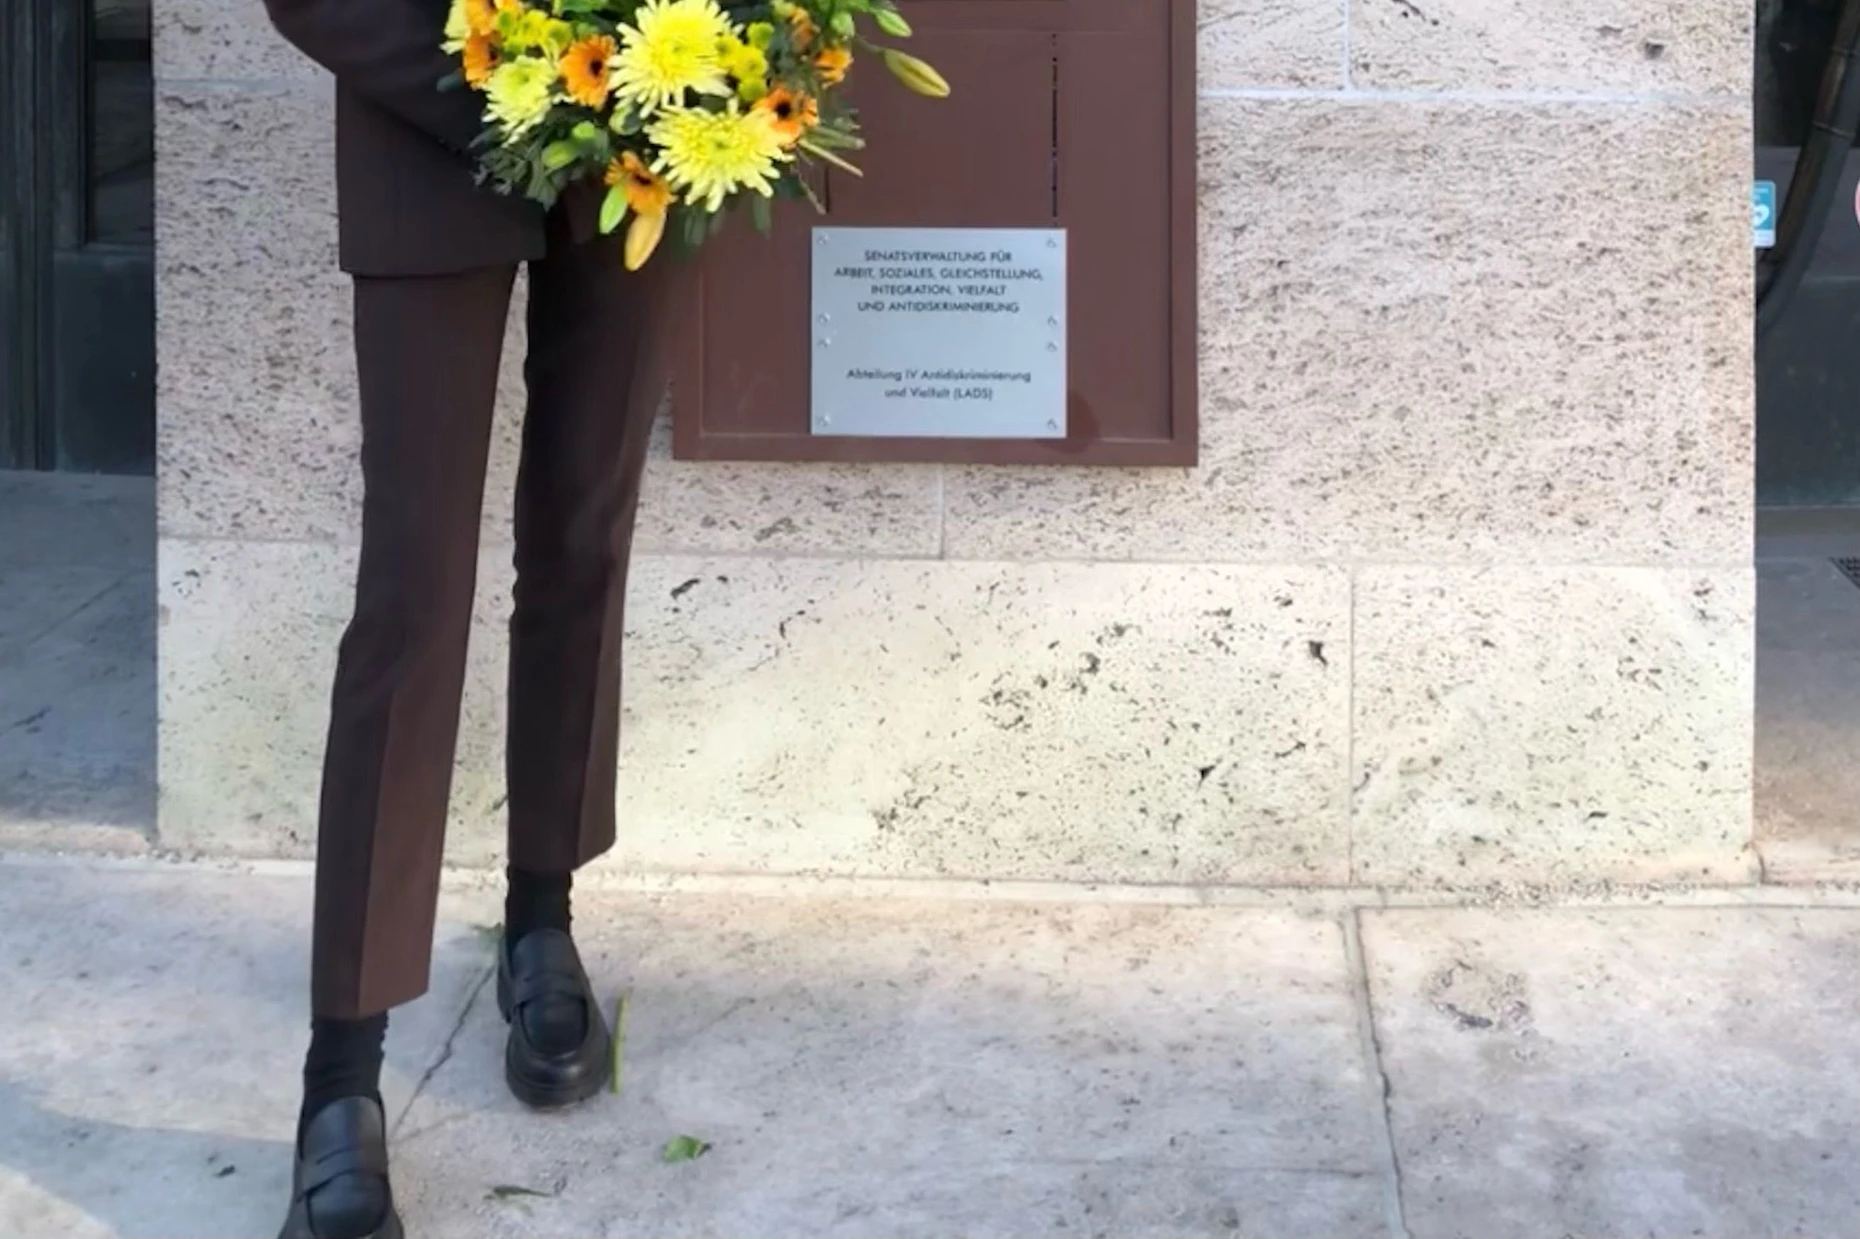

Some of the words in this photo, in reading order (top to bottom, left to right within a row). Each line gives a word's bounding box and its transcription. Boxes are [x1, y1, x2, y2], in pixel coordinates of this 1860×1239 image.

[864, 250, 986, 262] SENATSVERWALTUNG
[990, 249, 1012, 262] FÜR
[940, 268, 1043, 281] GLEICHSTELLUNG,
[958, 285, 1007, 297] VIELFALT
[857, 301, 885, 312] UND
[888, 301, 1019, 314] ANTIDISKRIMINIERUNG
[847, 368, 902, 382] Abteilung
[906, 370, 917, 381] IV
[921, 369, 1031, 383] Antidiskriminierung
[885, 387, 907, 400] und
[910, 387, 950, 400] Vielfalt
[953, 388, 993, 401] (LADS)
